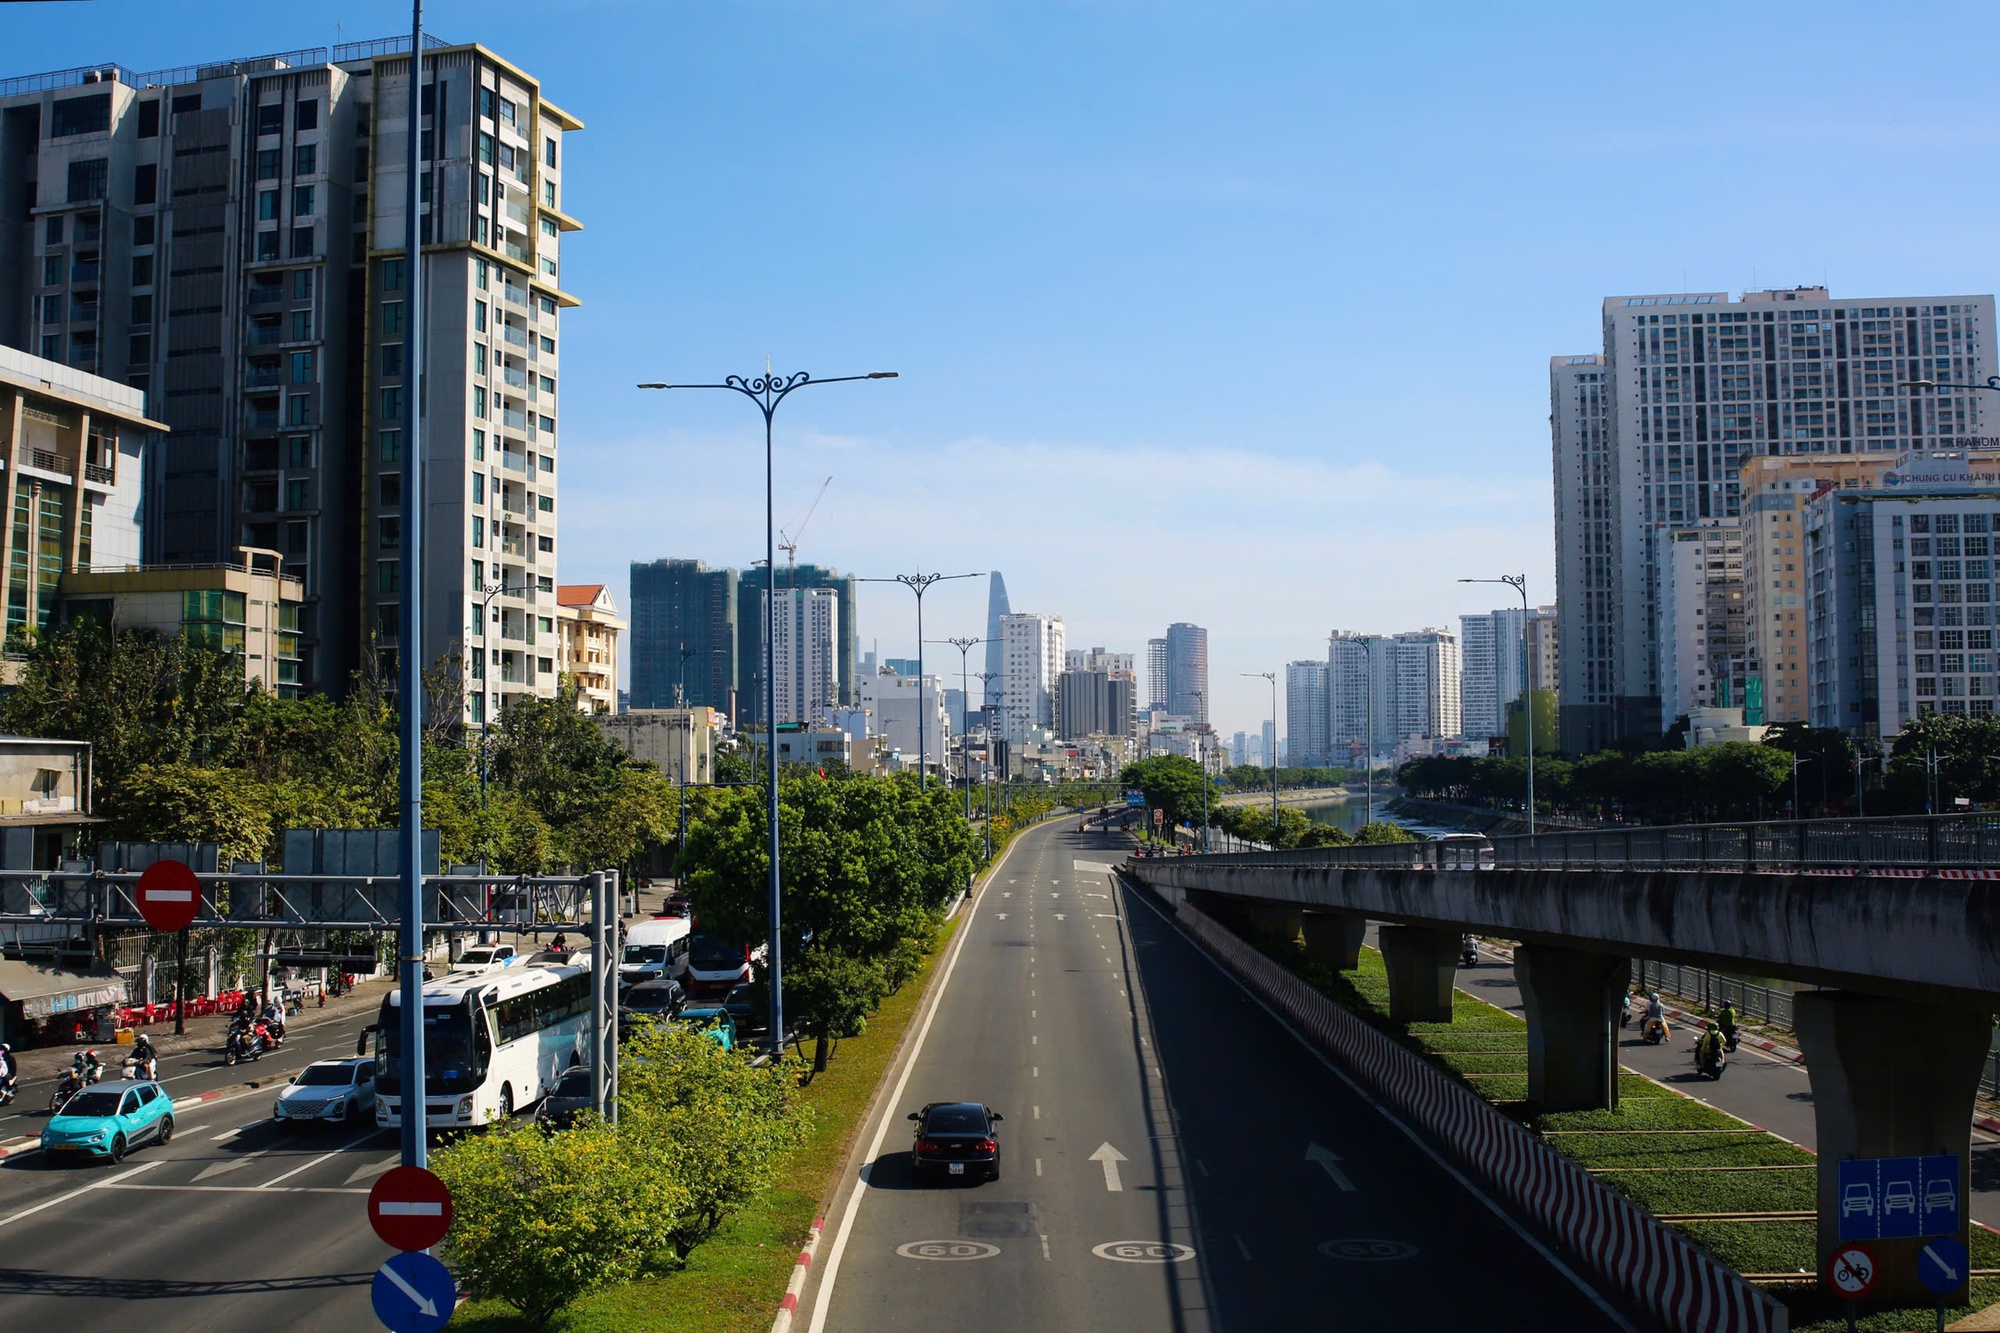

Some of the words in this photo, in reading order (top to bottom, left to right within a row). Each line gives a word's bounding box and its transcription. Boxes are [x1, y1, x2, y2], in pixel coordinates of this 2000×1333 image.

[1904, 474, 1940, 482] CHUNG
[919, 1245, 978, 1257] 60
[1115, 1246, 1175, 1258] 60
